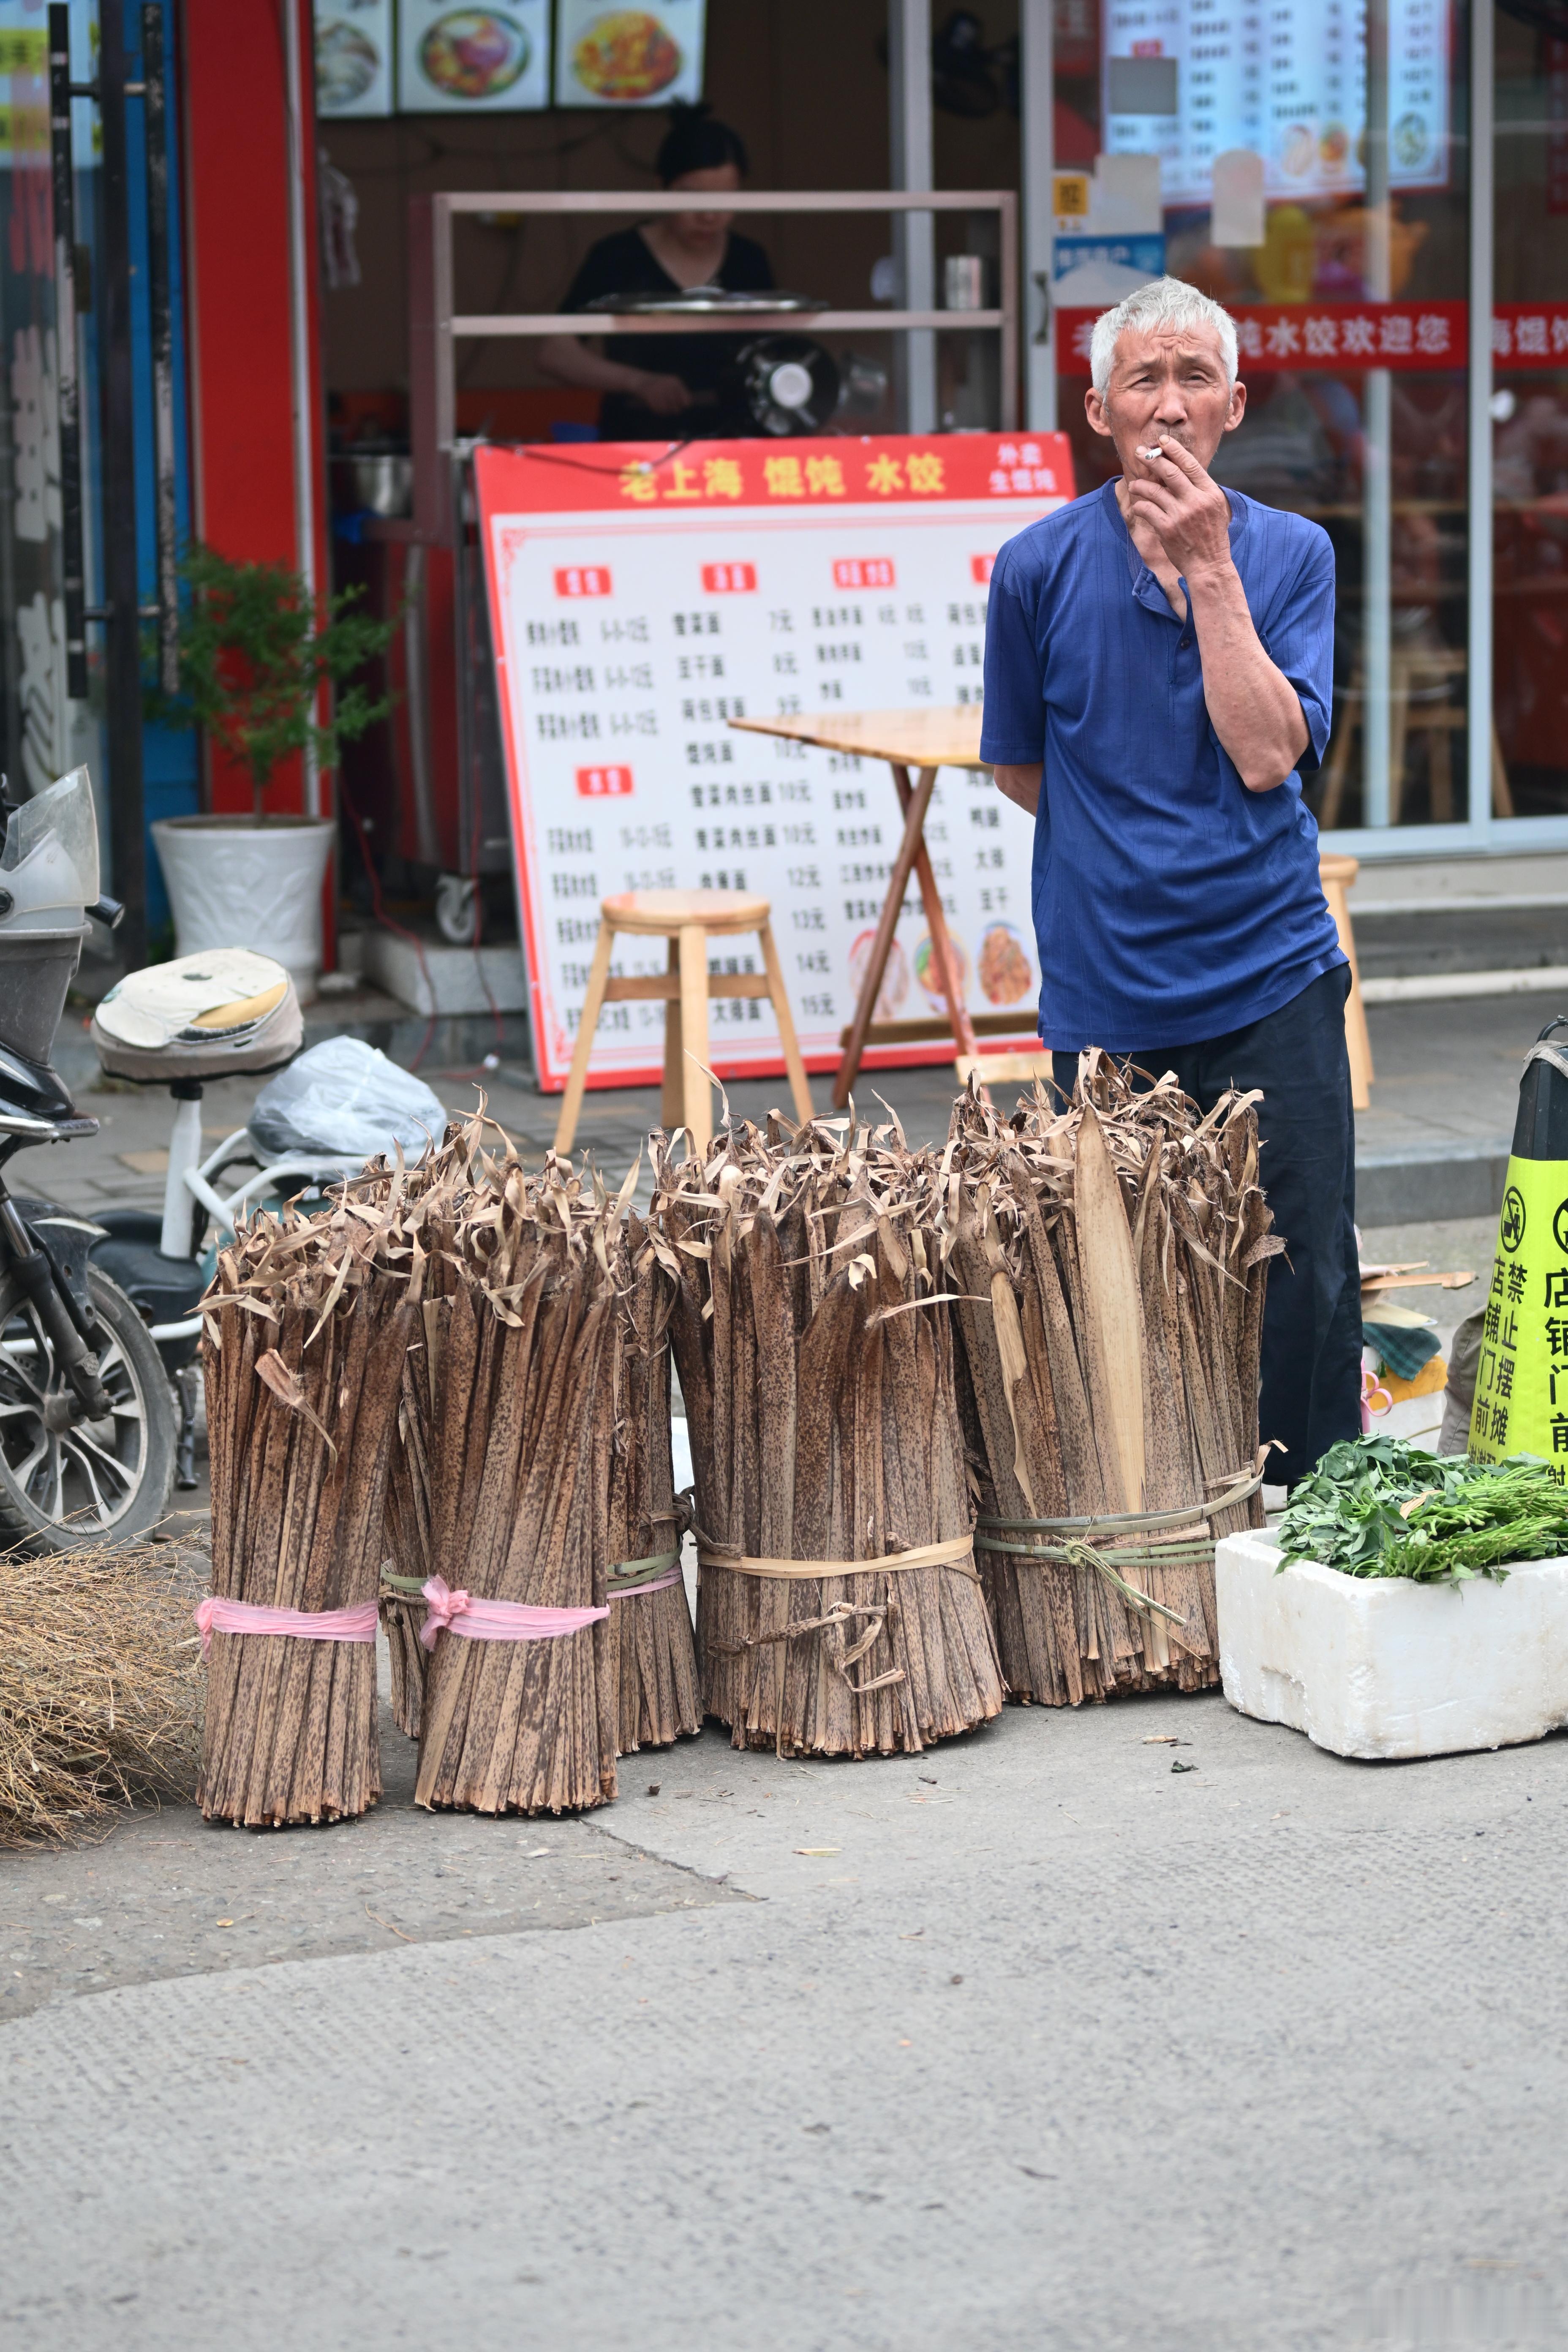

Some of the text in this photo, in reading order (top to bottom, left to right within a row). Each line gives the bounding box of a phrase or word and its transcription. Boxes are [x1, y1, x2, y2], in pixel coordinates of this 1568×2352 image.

[997, 443, 1043, 466] 外卖
[620, 453, 945, 501] 老上海 馄饨 水饺
[988, 467, 1056, 494] 生馄饨
[788, 864, 822, 889] 12元
[792, 906, 828, 931] 13元
[797, 950, 832, 974] 14元
[801, 993, 836, 1018] 15元
[1475, 1255, 1505, 1438] 店铺门前
[1489, 1260, 1528, 1446] 禁止摆摊
[1468, 1442, 1505, 1468] 谢谢配
